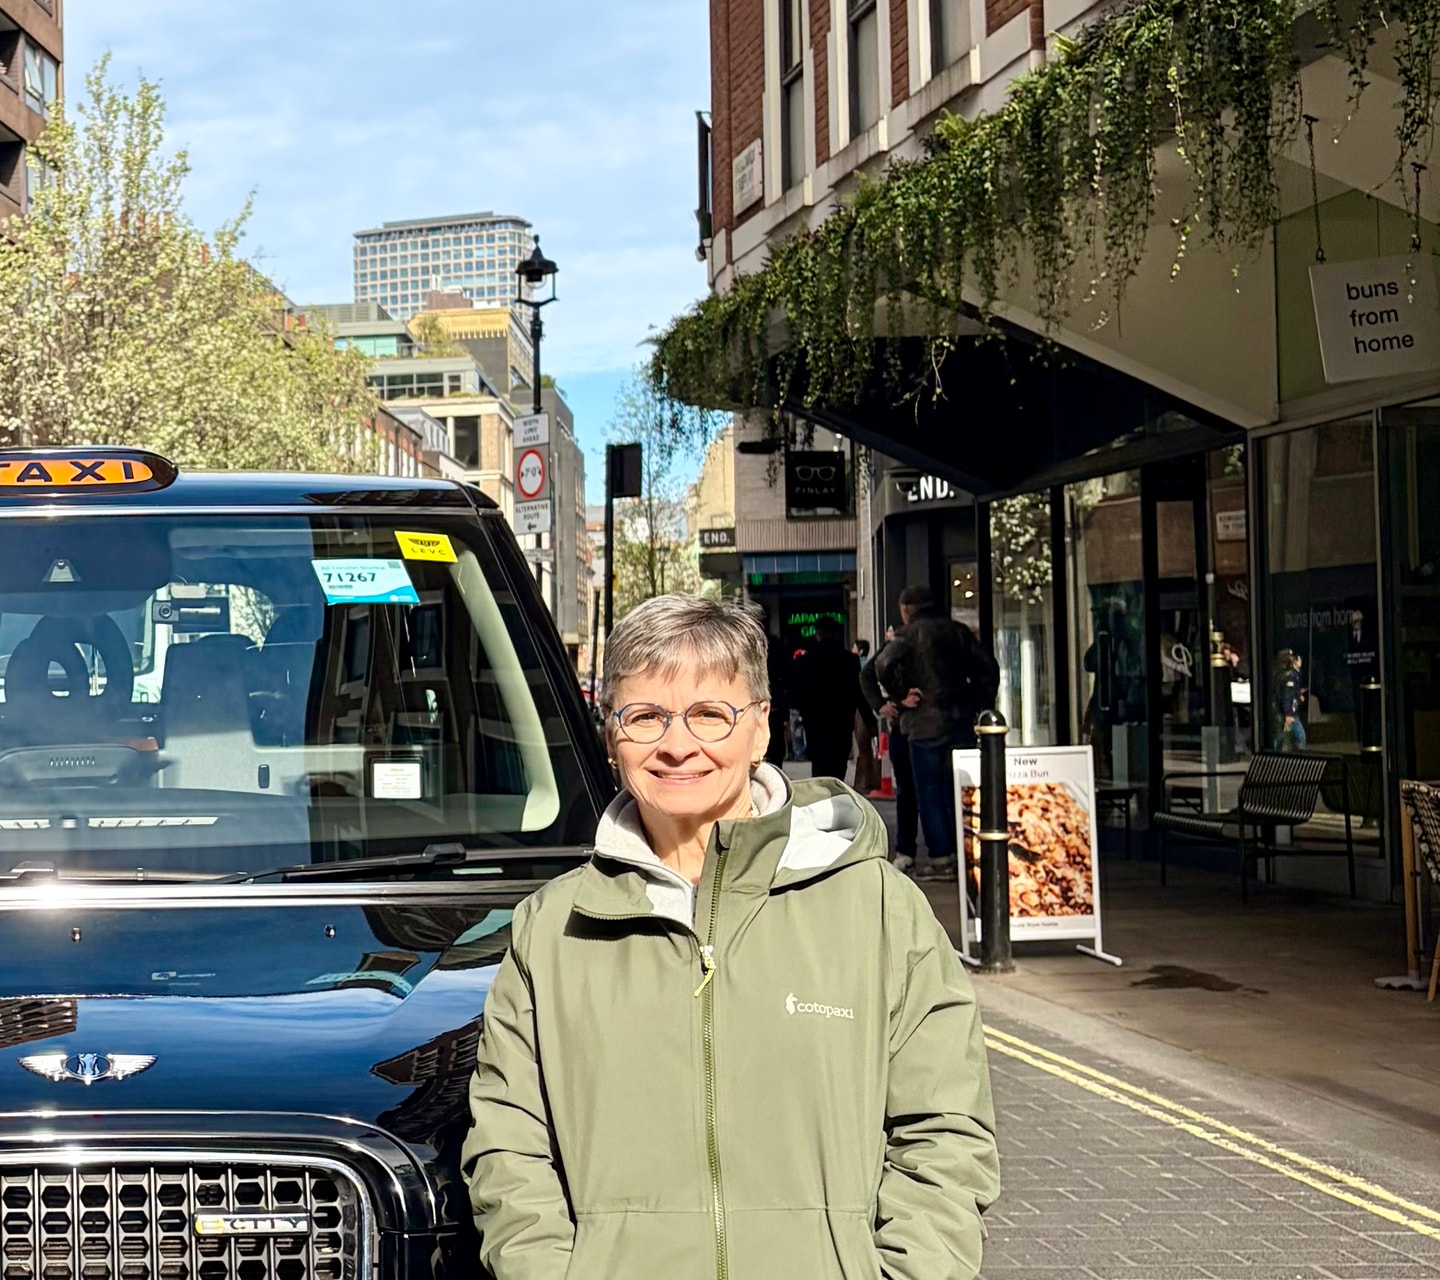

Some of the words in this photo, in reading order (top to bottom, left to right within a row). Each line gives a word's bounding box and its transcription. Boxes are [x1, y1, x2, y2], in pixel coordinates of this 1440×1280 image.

[1346, 282, 1399, 300] buns
[1350, 309, 1399, 327] from
[1354, 334, 1414, 354] home
[795, 486, 836, 495] FINLAY
[704, 531, 730, 545] END.
[323, 572, 376, 583] 71267
[1014, 757, 1038, 766] New
[796, 1001, 854, 1019] cotopaxi
